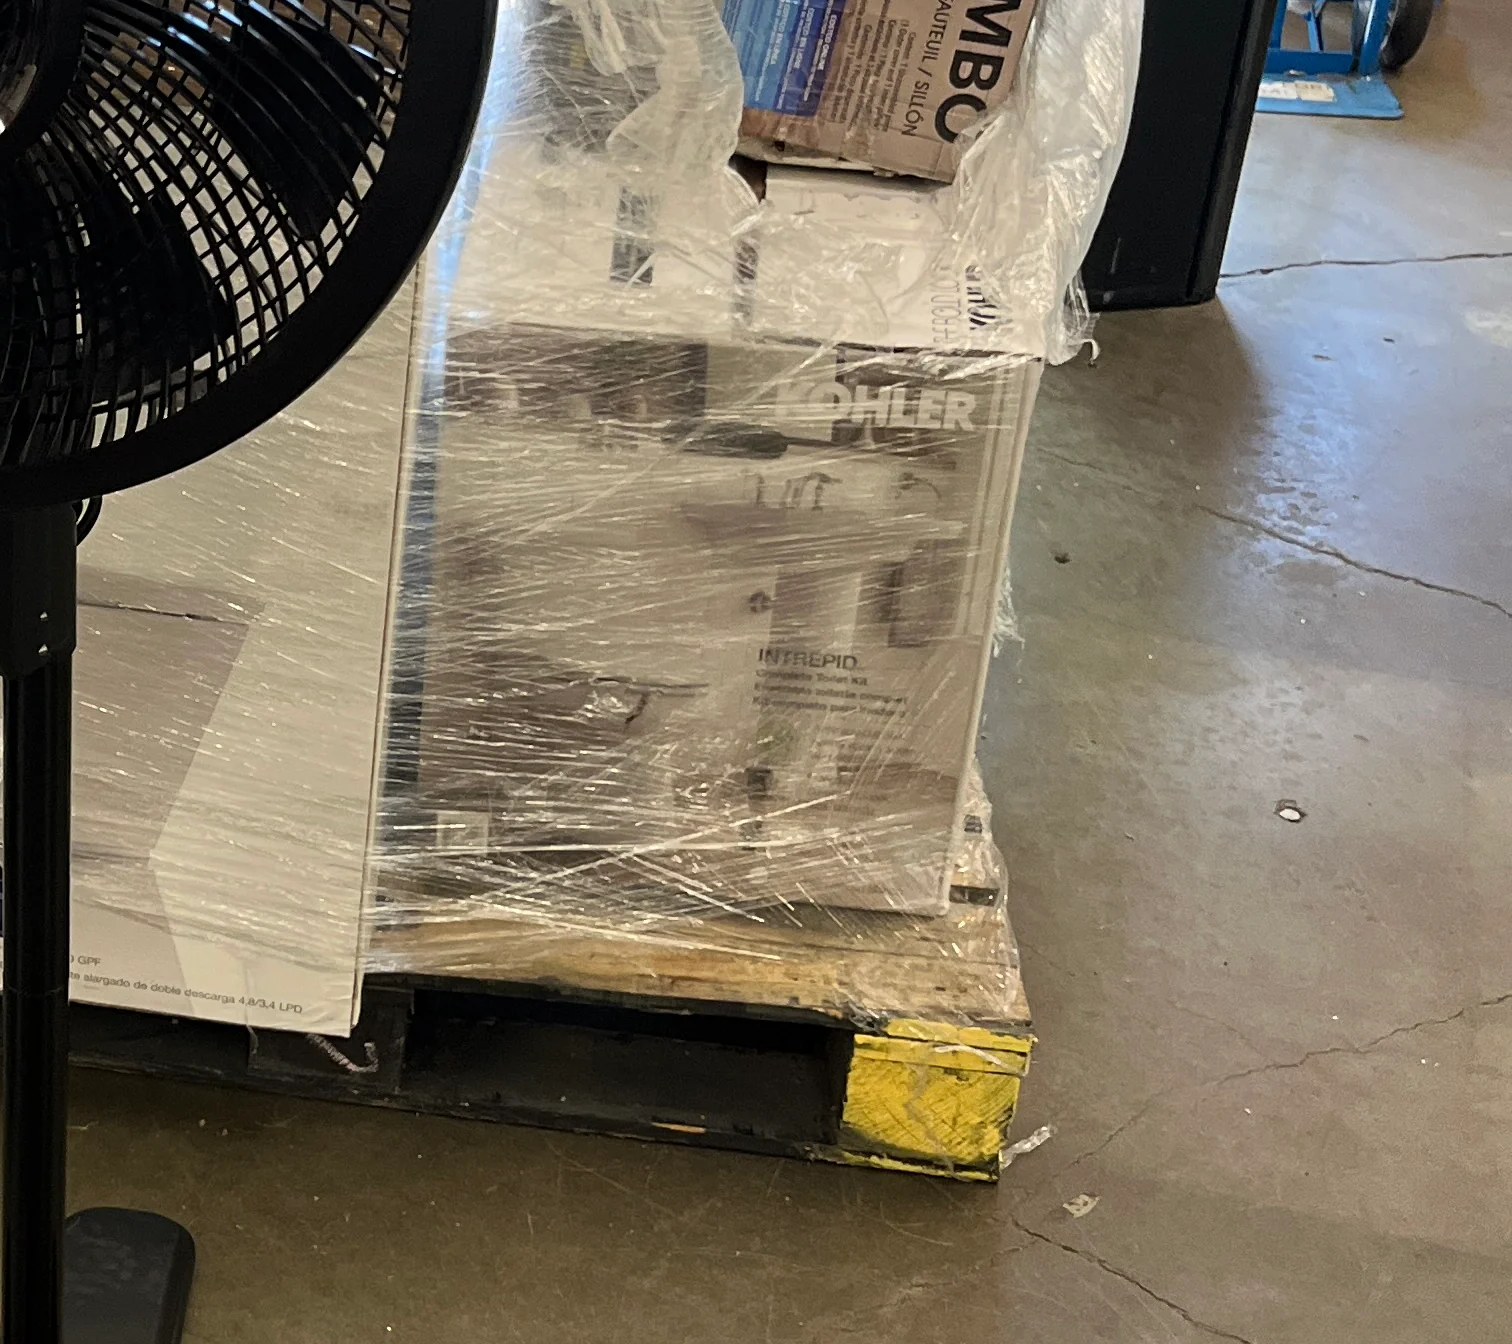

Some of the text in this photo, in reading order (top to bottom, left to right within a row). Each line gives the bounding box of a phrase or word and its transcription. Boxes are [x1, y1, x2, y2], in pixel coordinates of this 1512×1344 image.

[901, 81, 930, 137] SILLÓN
[757, 648, 858, 670] INTREPID
[82, 971, 131, 988] alargado
[132, 979, 148, 991] de
[149, 982, 182, 997] doble
[184, 987, 236, 1006] descarga
[278, 1001, 304, 1015] LPD
